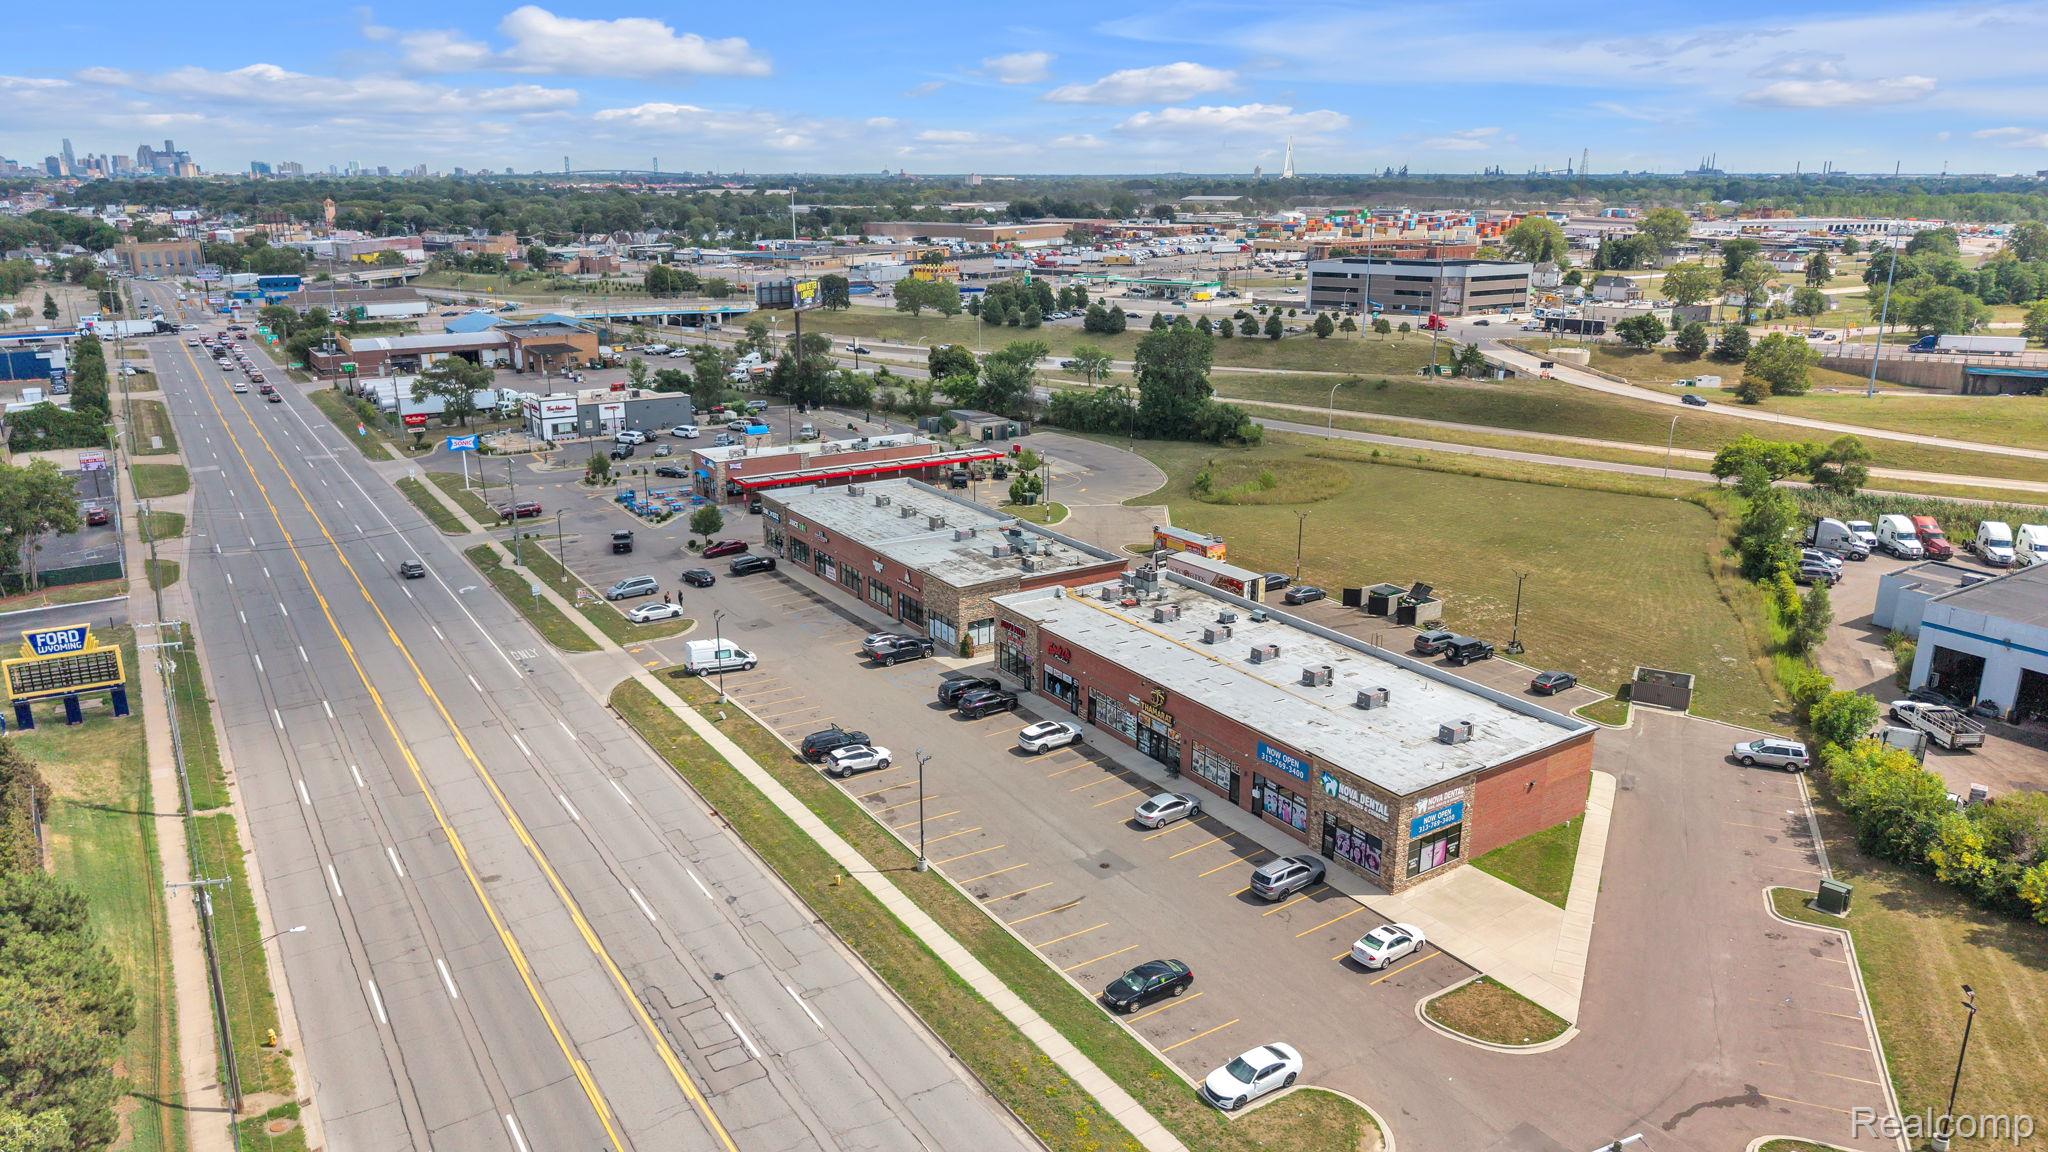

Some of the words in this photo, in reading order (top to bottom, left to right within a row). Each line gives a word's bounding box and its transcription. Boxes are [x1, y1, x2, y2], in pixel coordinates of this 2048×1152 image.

[36, 630, 79, 646] FORD
[37, 641, 82, 654] WYOMING
[511, 648, 539, 660] ONLY
[1141, 701, 1173, 723] THAMARAT
[1261, 752, 1304, 779] 313-769-3400
[1267, 746, 1281, 758] NOW
[1282, 754, 1300, 768] OPEN
[1338, 783, 1358, 802] NOVA
[1360, 794, 1390, 817] DENTAL
[1428, 794, 1443, 805] NOVA
[1444, 786, 1465, 800] DENTAL
[1423, 814, 1437, 825] NOW
[1438, 808, 1452, 819] OPEN
